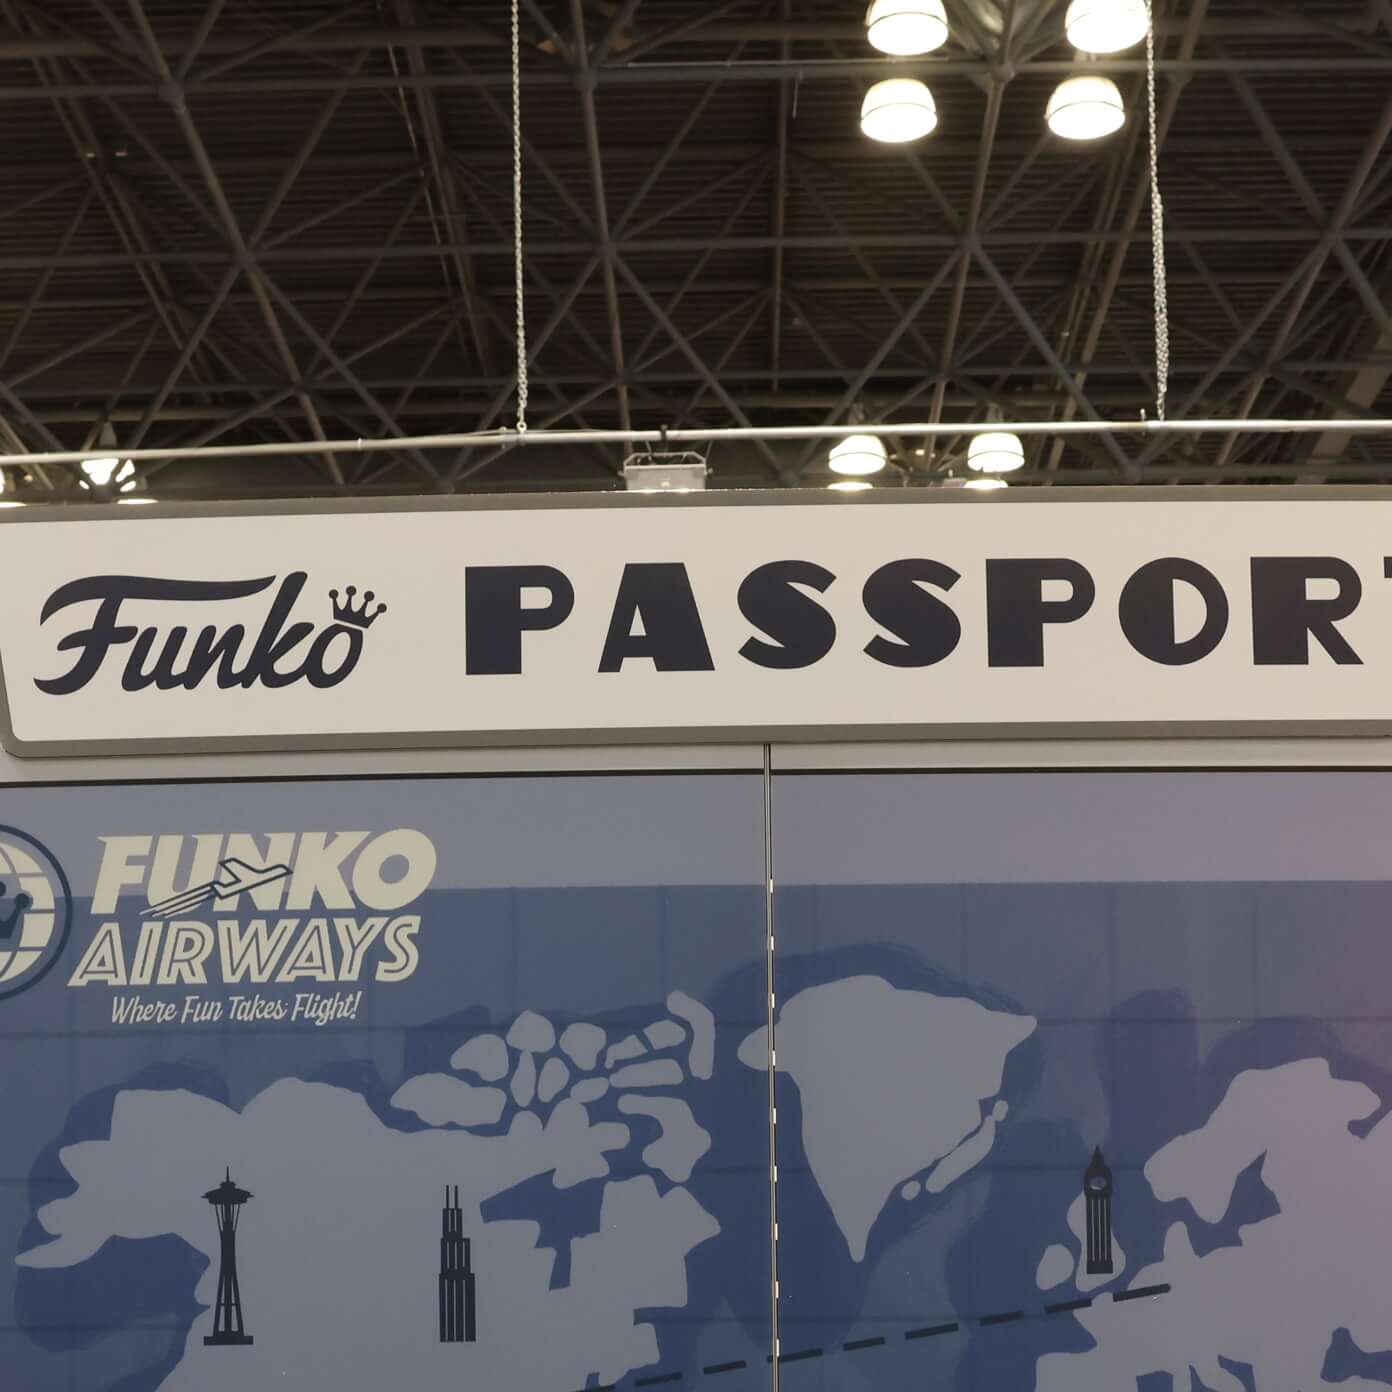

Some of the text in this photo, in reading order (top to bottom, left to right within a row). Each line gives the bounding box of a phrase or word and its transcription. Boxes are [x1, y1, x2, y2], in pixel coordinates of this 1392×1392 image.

[33, 570, 376, 697] Funko
[89, 827, 438, 915] FUNKO
[66, 914, 423, 988] AIRWAYS
[110, 991, 363, 1027] Where Fun Takes Flight!
